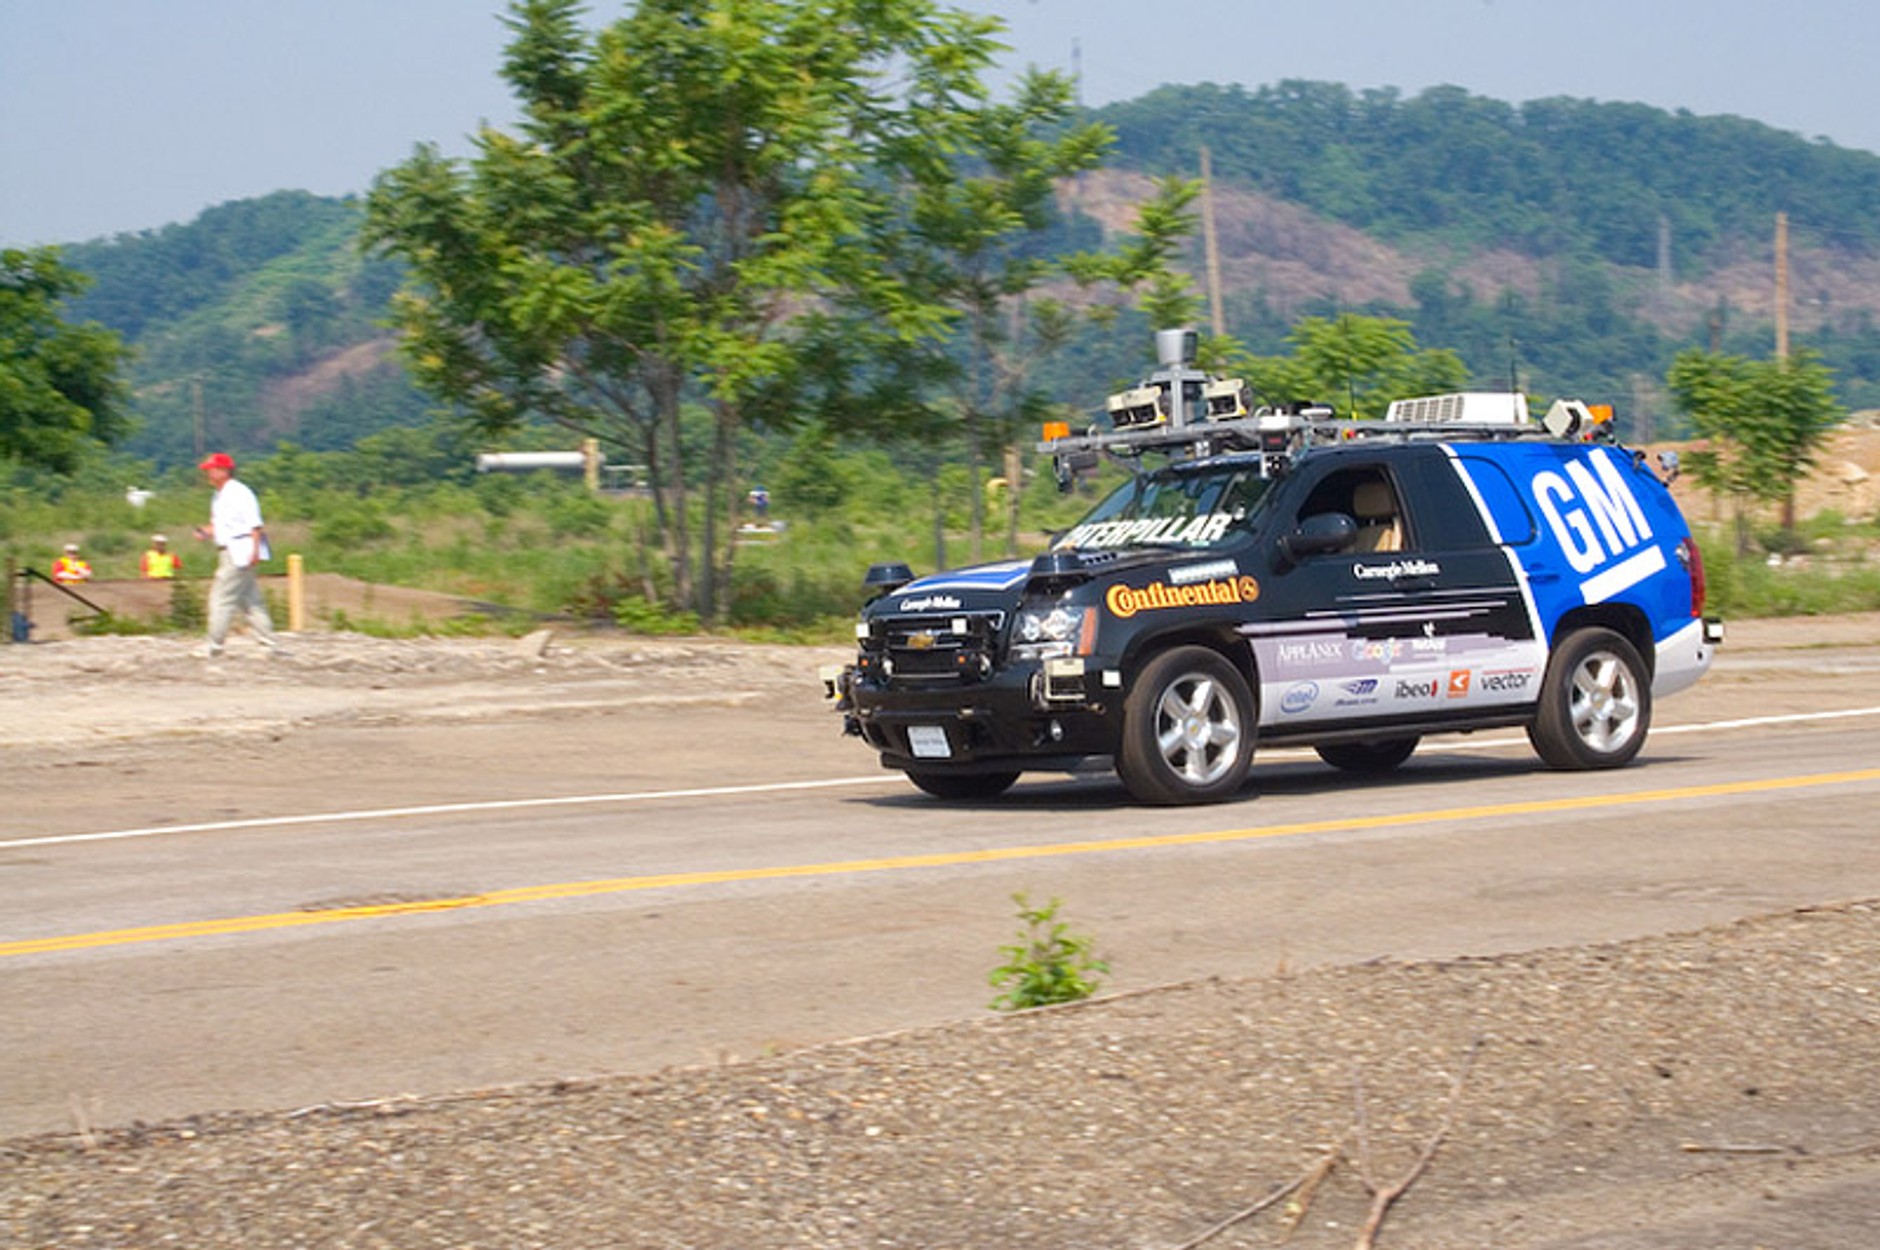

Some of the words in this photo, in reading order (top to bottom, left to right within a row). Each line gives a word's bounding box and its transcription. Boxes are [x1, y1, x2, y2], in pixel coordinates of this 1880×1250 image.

[1532, 447, 1653, 573] GM
[1052, 513, 1232, 551] ATERPILLAR
[1106, 576, 1242, 618] Continental
[1394, 680, 1430, 698] ibeo
[1481, 671, 1531, 690] vector
